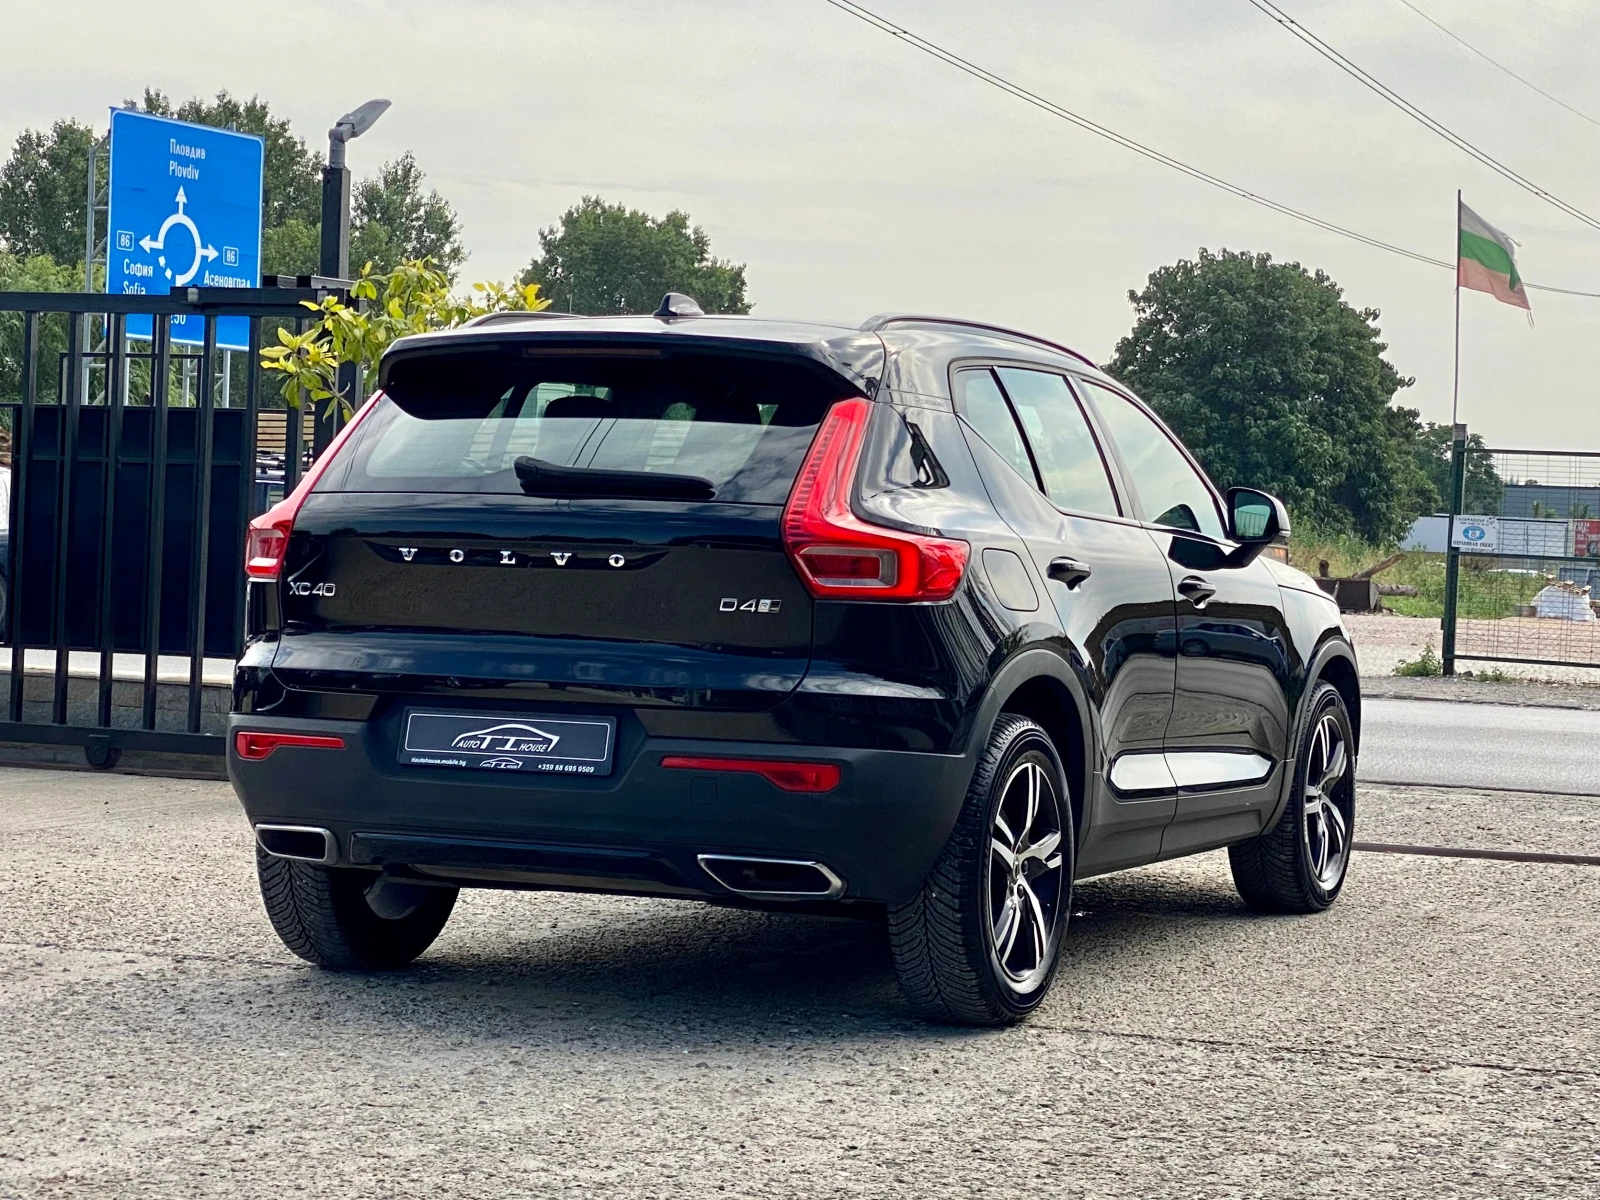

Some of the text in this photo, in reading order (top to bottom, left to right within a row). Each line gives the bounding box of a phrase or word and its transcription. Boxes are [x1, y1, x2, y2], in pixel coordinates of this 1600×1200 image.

[170, 138, 206, 160] Пловдив
[169, 160, 200, 181] Plovdiv
[120, 234, 131, 247] 86
[226, 250, 236, 263] 86
[123, 258, 154, 278] София
[398, 547, 626, 569] VOLVO
[289, 581, 336, 597] XC40
[719, 597, 757, 613] D4
[456, 740, 480, 749] AUTO
[518, 743, 549, 753] HOUSE
[537, 763, 554, 771] +359
